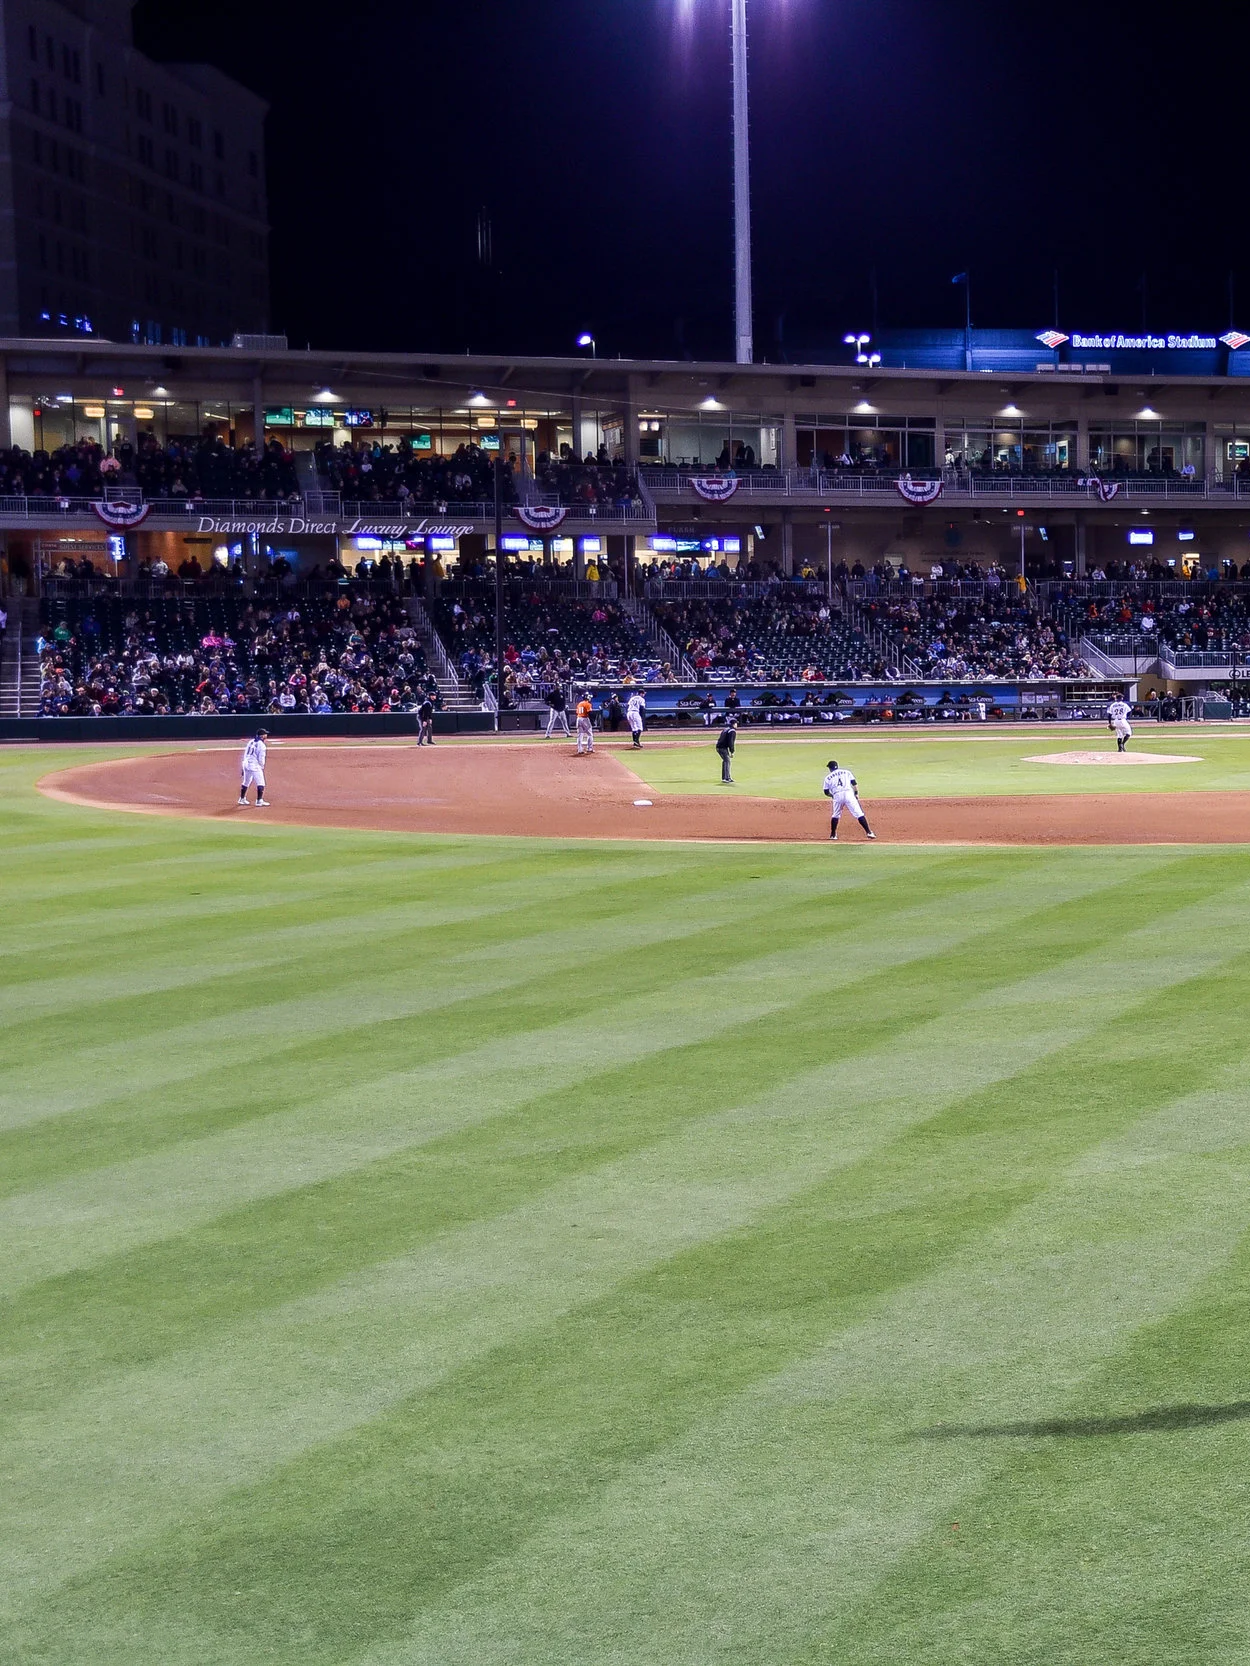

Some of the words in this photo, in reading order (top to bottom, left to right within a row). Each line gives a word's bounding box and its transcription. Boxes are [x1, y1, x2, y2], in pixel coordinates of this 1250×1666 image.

[1073, 335, 1102, 348] Bank
[1103, 335, 1116, 348] of
[1116, 335, 1165, 348] America
[1168, 335, 1216, 348] Stadium
[197, 517, 284, 534] Diamonds
[288, 517, 336, 534] Direct
[342, 518, 408, 539] Luxury
[408, 518, 474, 536] Lounge
